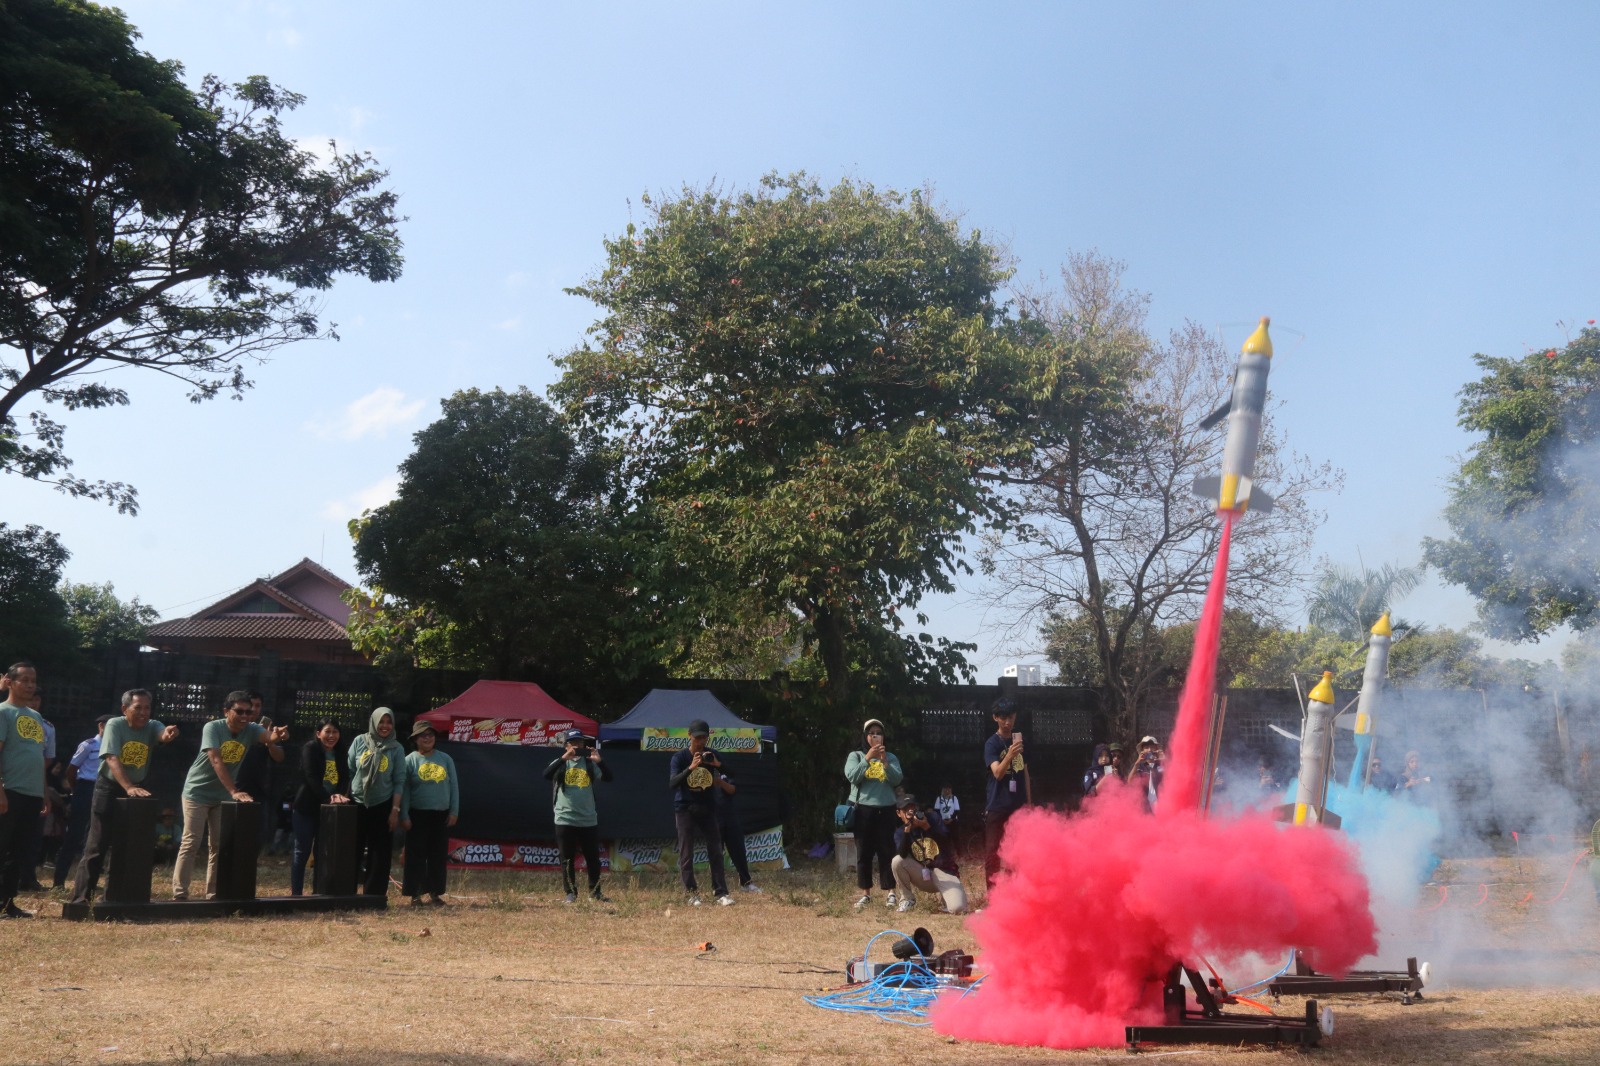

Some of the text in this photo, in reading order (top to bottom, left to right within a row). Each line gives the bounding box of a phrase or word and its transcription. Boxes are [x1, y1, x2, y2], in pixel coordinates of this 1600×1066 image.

[453, 719, 472, 727] SOSIS
[501, 721, 523, 730] FRENCH
[452, 725, 474, 734] BAKAR
[646, 736, 756, 750] DJOERA MANGGO
[745, 831, 782, 849] SINAN
[466, 845, 501, 854] SOSIS
[518, 845, 560, 857] CORNDO
[744, 846, 784, 863] ANGGA
[464, 853, 503, 863] BAKAR
[523, 854, 561, 865] MOZZA
[631, 848, 661, 866] THAI
